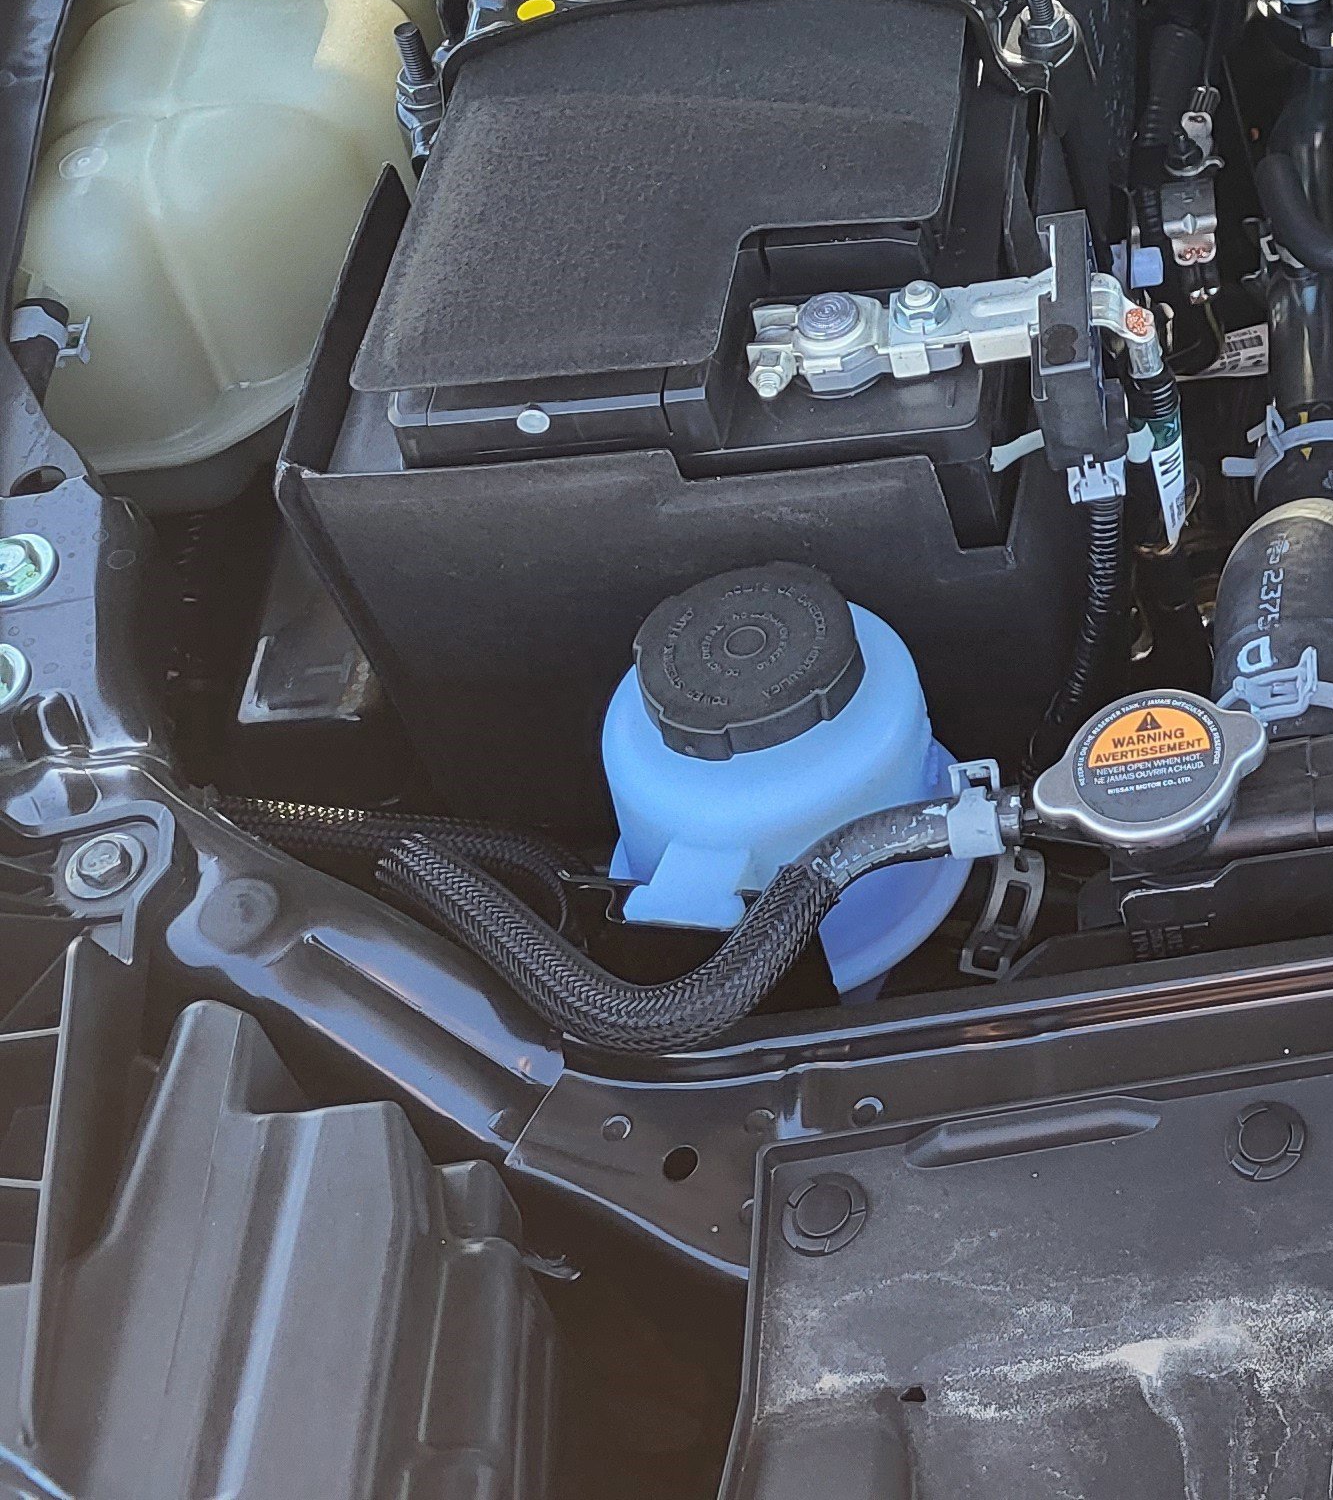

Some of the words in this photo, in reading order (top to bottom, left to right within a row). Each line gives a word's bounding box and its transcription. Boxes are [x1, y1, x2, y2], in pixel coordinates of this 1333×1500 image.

[1112, 727, 1185, 749] WARNING
[1094, 737, 1204, 764] AVERTISSEMENT
[1096, 764, 1126, 776] NEVER
[1126, 760, 1151, 772] OPEN
[1153, 756, 1181, 767] WHEN
[1106, 772, 1135, 784] JAMAIS
